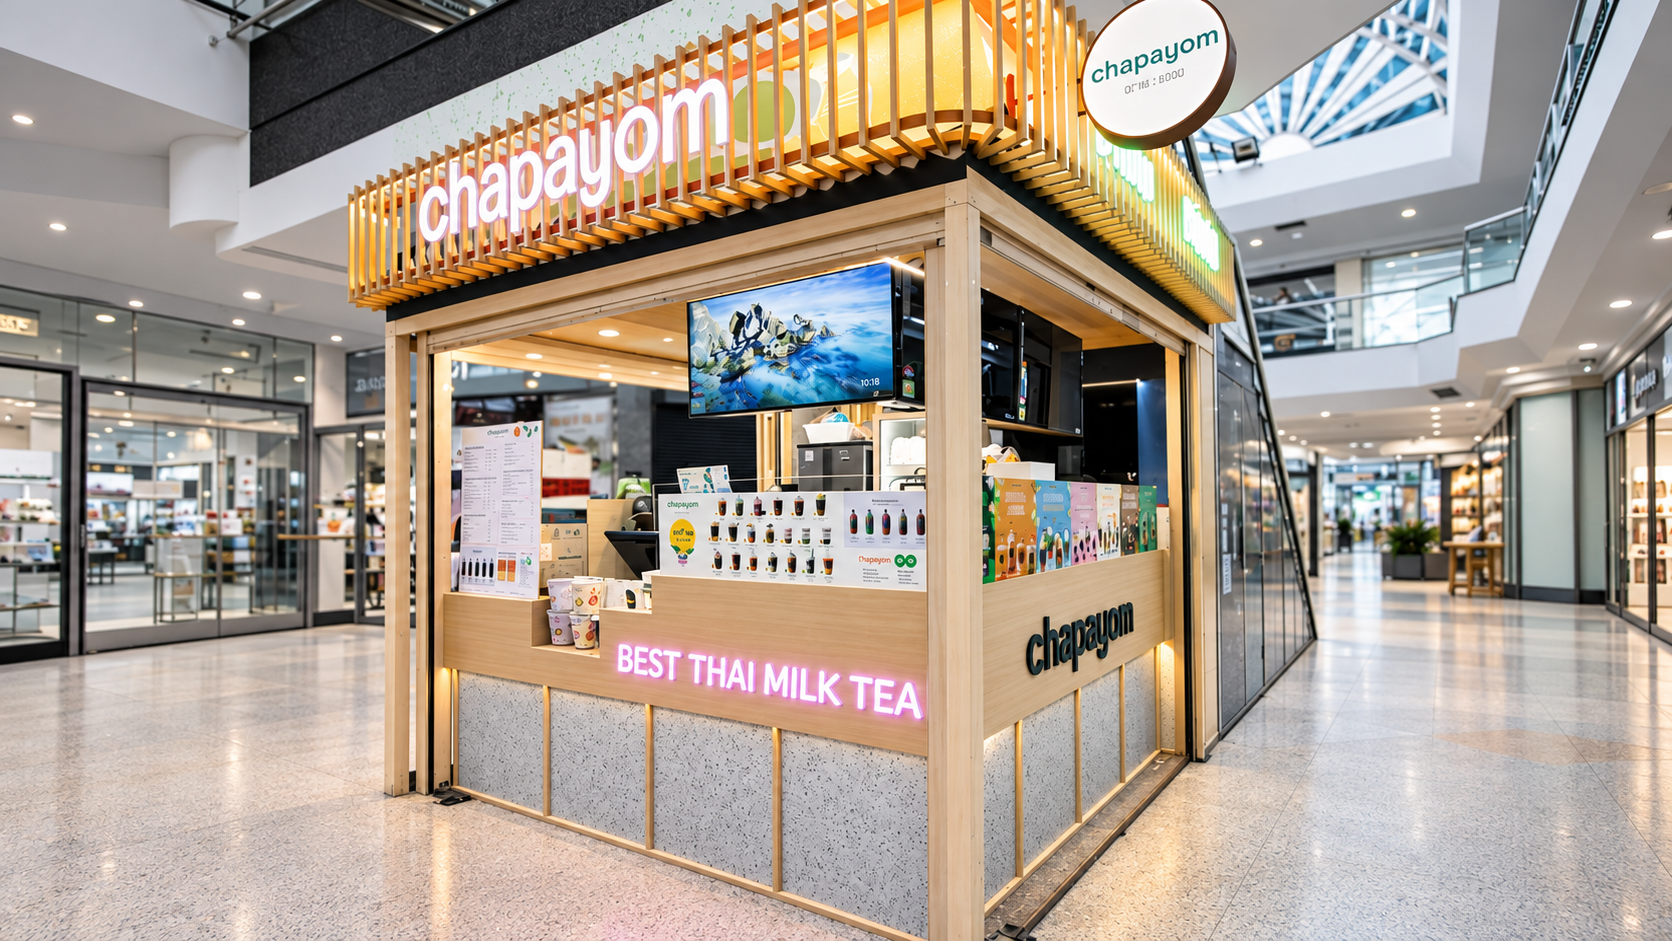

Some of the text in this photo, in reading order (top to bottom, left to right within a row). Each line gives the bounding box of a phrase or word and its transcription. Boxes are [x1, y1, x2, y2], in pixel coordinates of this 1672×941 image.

[1091, 29, 1219, 84] chapayom
[418, 78, 730, 243] chapayom
[860, 377, 880, 387] 10:18
[666, 500, 700, 510] chapayom
[1025, 601, 1135, 676] chapayom
[617, 643, 924, 720] BEST THAI MILK TEA
